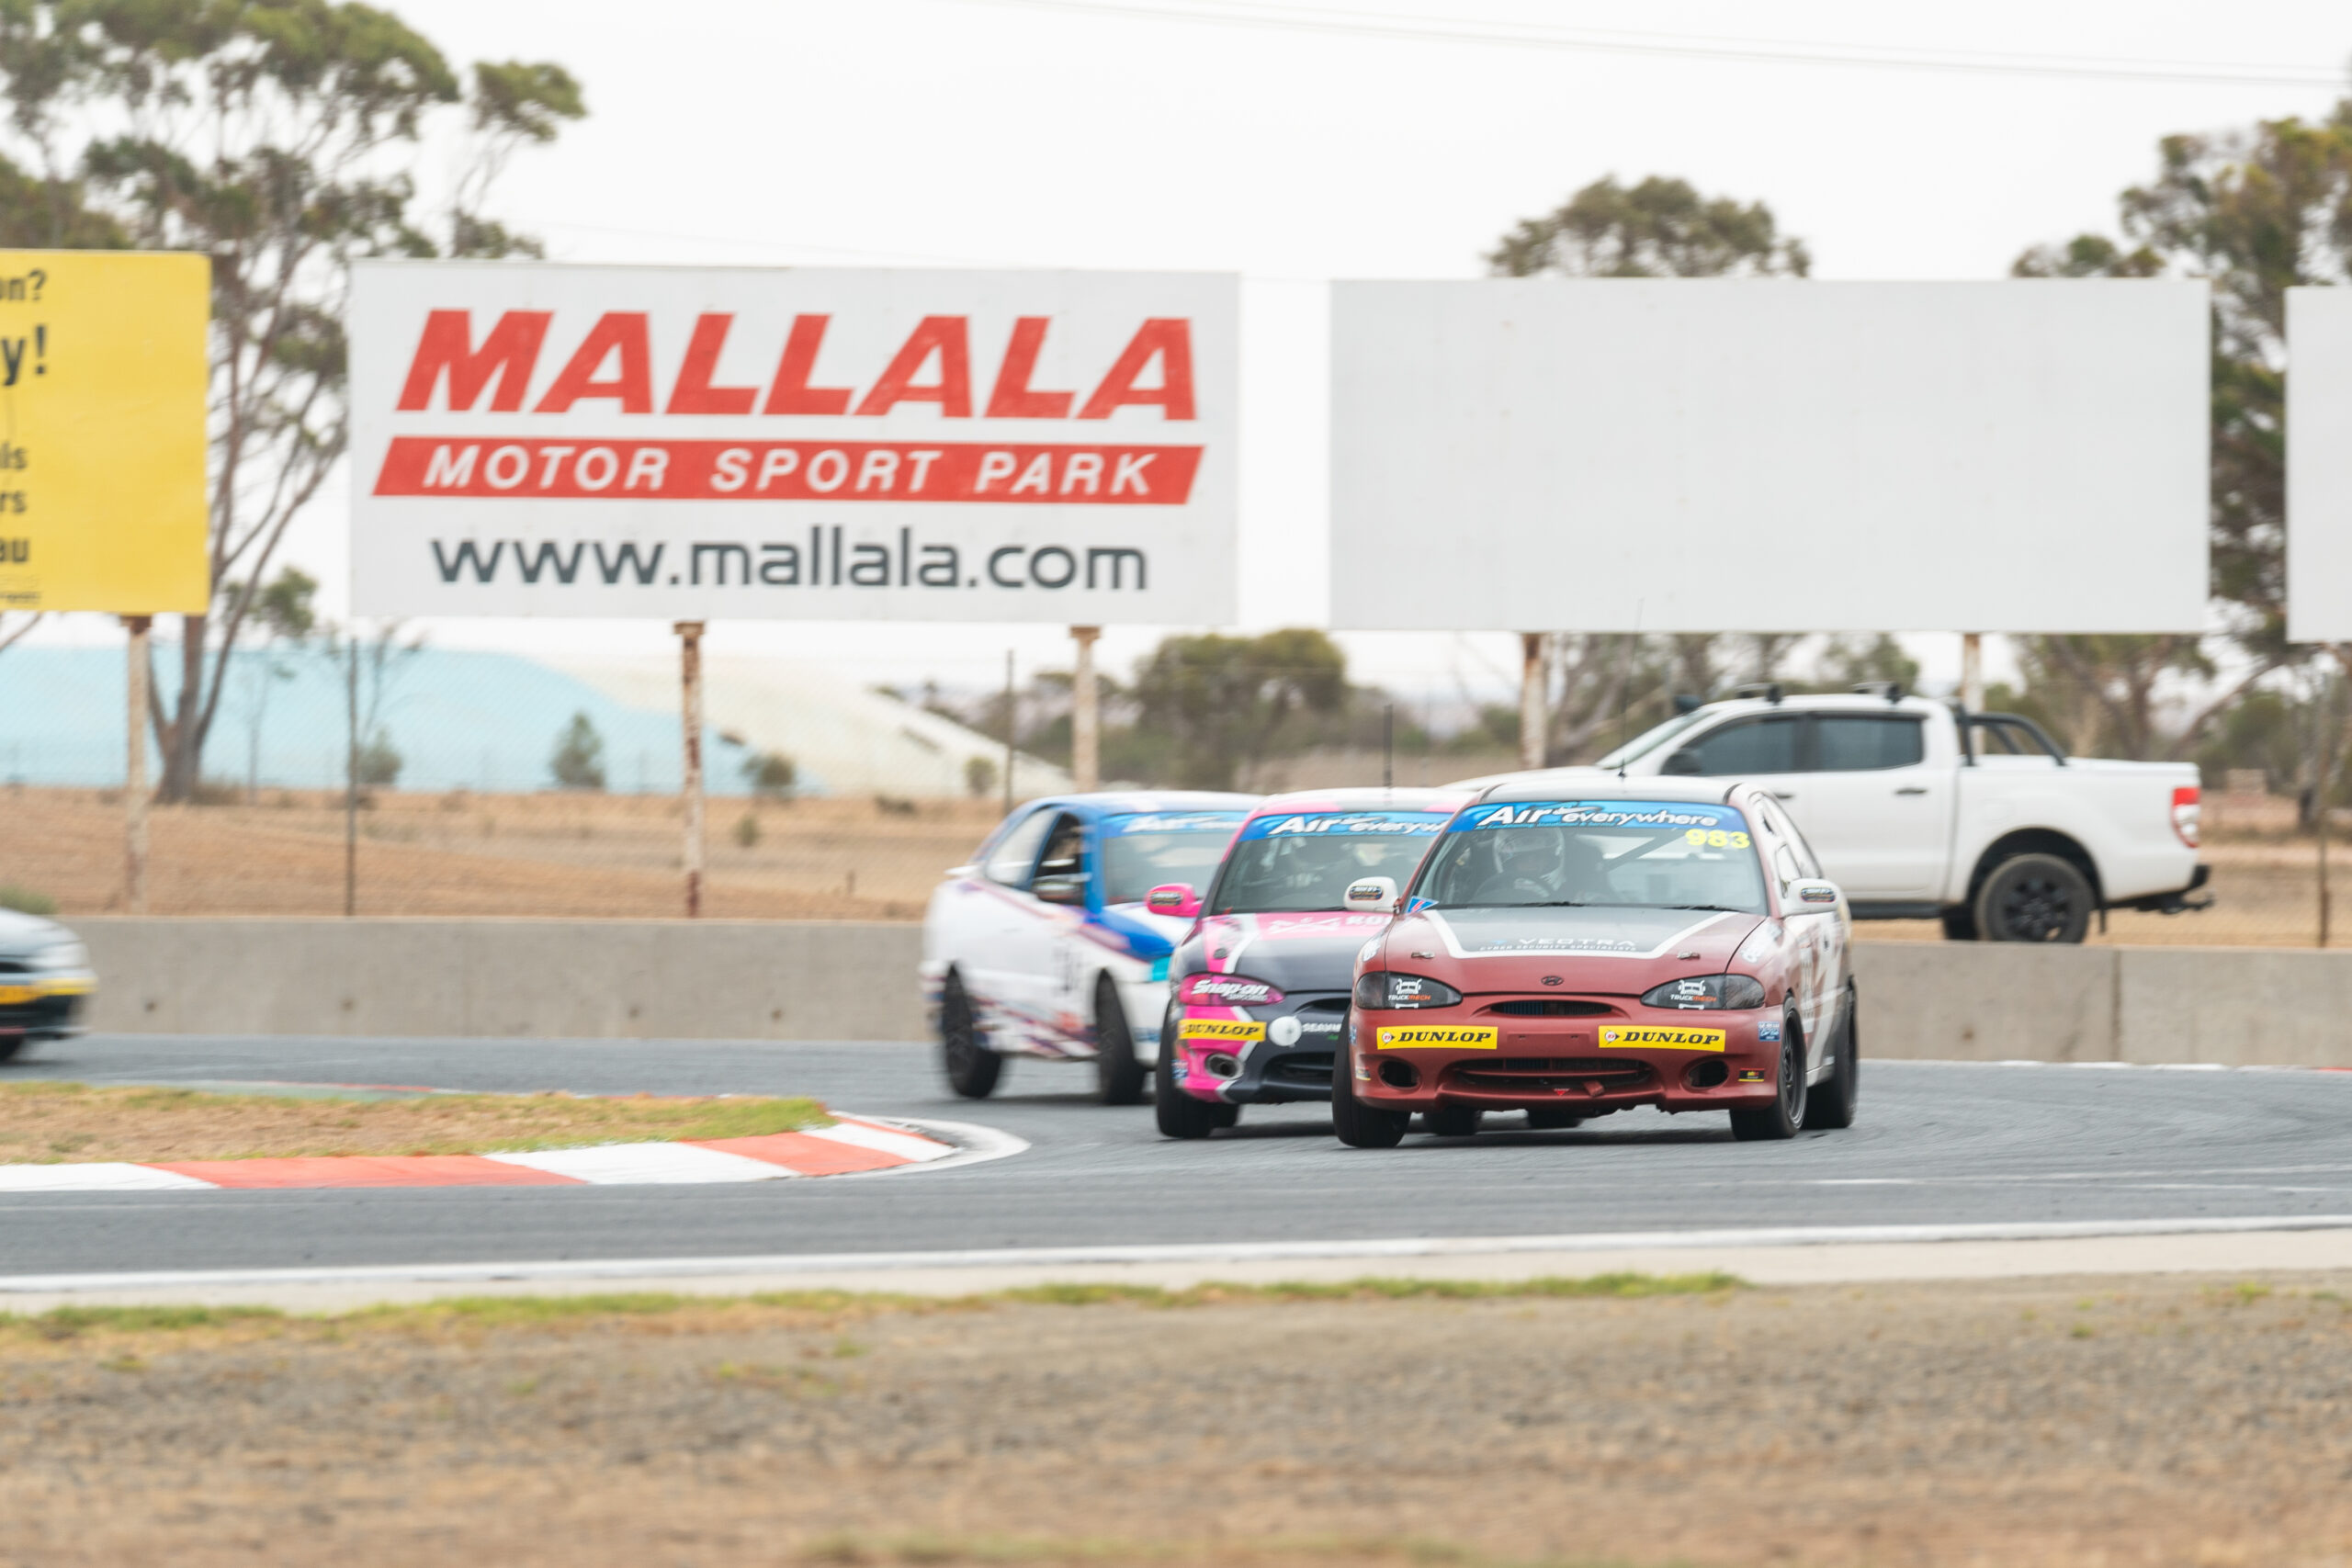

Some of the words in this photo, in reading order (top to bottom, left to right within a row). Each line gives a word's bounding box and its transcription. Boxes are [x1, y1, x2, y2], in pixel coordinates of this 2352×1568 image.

[395, 309, 1198, 422] MALLALA
[423, 445, 671, 491] MOTOR
[710, 446, 940, 495] SPORT
[974, 452, 1159, 498] PARK
[429, 525, 1149, 592] www.mallala.com
[1268, 816, 1340, 834] Air
[1479, 806, 1554, 825] Air
[1562, 808, 1720, 827] everywhere
[1685, 829, 1750, 849] 983
[1191, 979, 1270, 998] Snap-on
[1187, 1024, 1261, 1036] DUNLOP
[1397, 1032, 1492, 1043] DUNLOP
[1623, 1032, 1720, 1044] DUNLOP
